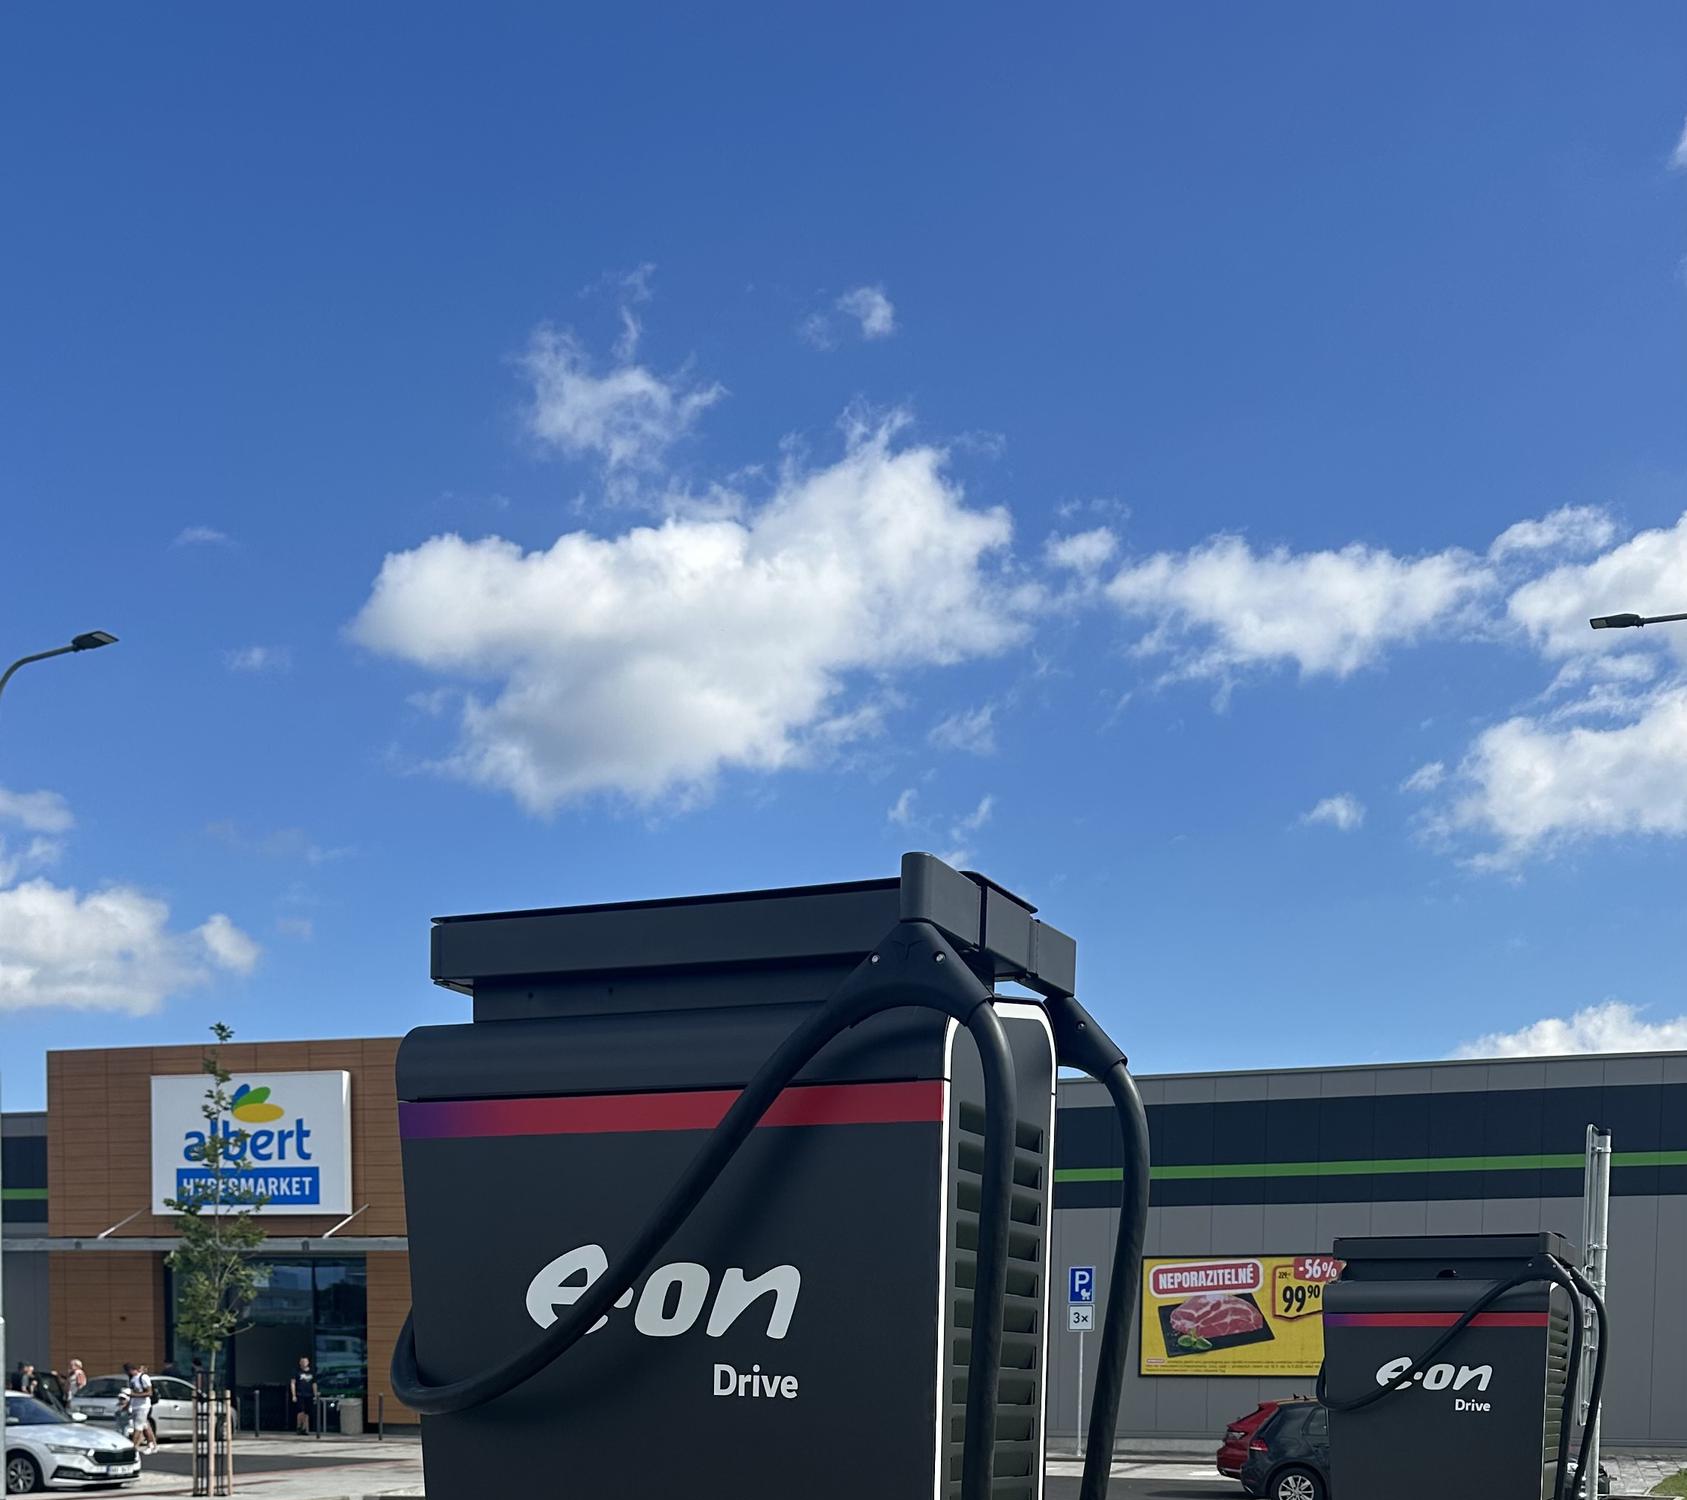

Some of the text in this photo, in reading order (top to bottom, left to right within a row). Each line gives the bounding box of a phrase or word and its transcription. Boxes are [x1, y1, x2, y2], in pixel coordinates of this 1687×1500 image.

[1158, 1264, 1255, 1290] NEPORAZITELNÉ
[1299, 1259, 1337, 1279] -56%
[1074, 1271, 1090, 1293] P
[713, 1364, 799, 1399] Drive
[1455, 1399, 1491, 1412] Drive
